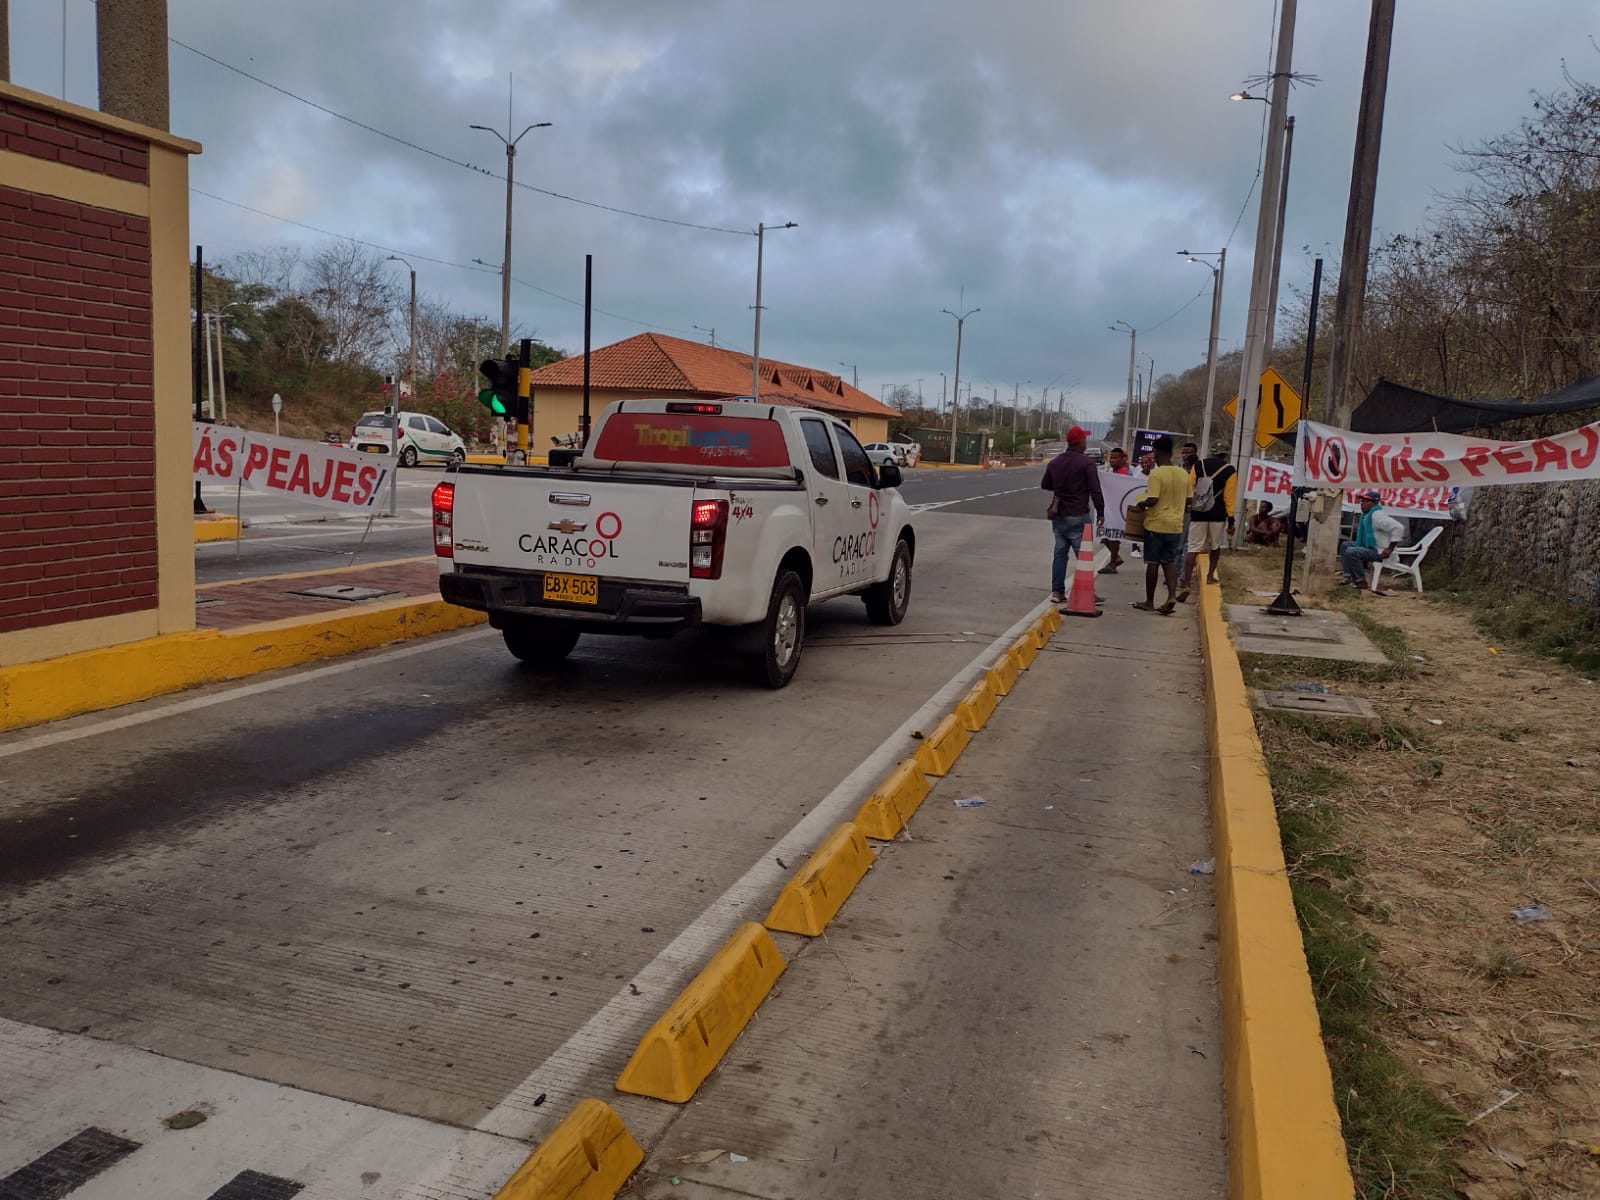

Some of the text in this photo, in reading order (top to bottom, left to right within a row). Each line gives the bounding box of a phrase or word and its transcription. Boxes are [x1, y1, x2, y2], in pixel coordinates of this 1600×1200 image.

[1304, 422, 1600, 483] NO MÁS PEAJ
[242, 443, 387, 506] PEAJES!
[518, 534, 619, 558] CARACOL
[833, 531, 876, 563] CARACOL
[537, 554, 596, 568] RADIO
[545, 576, 597, 596] EBX 503
